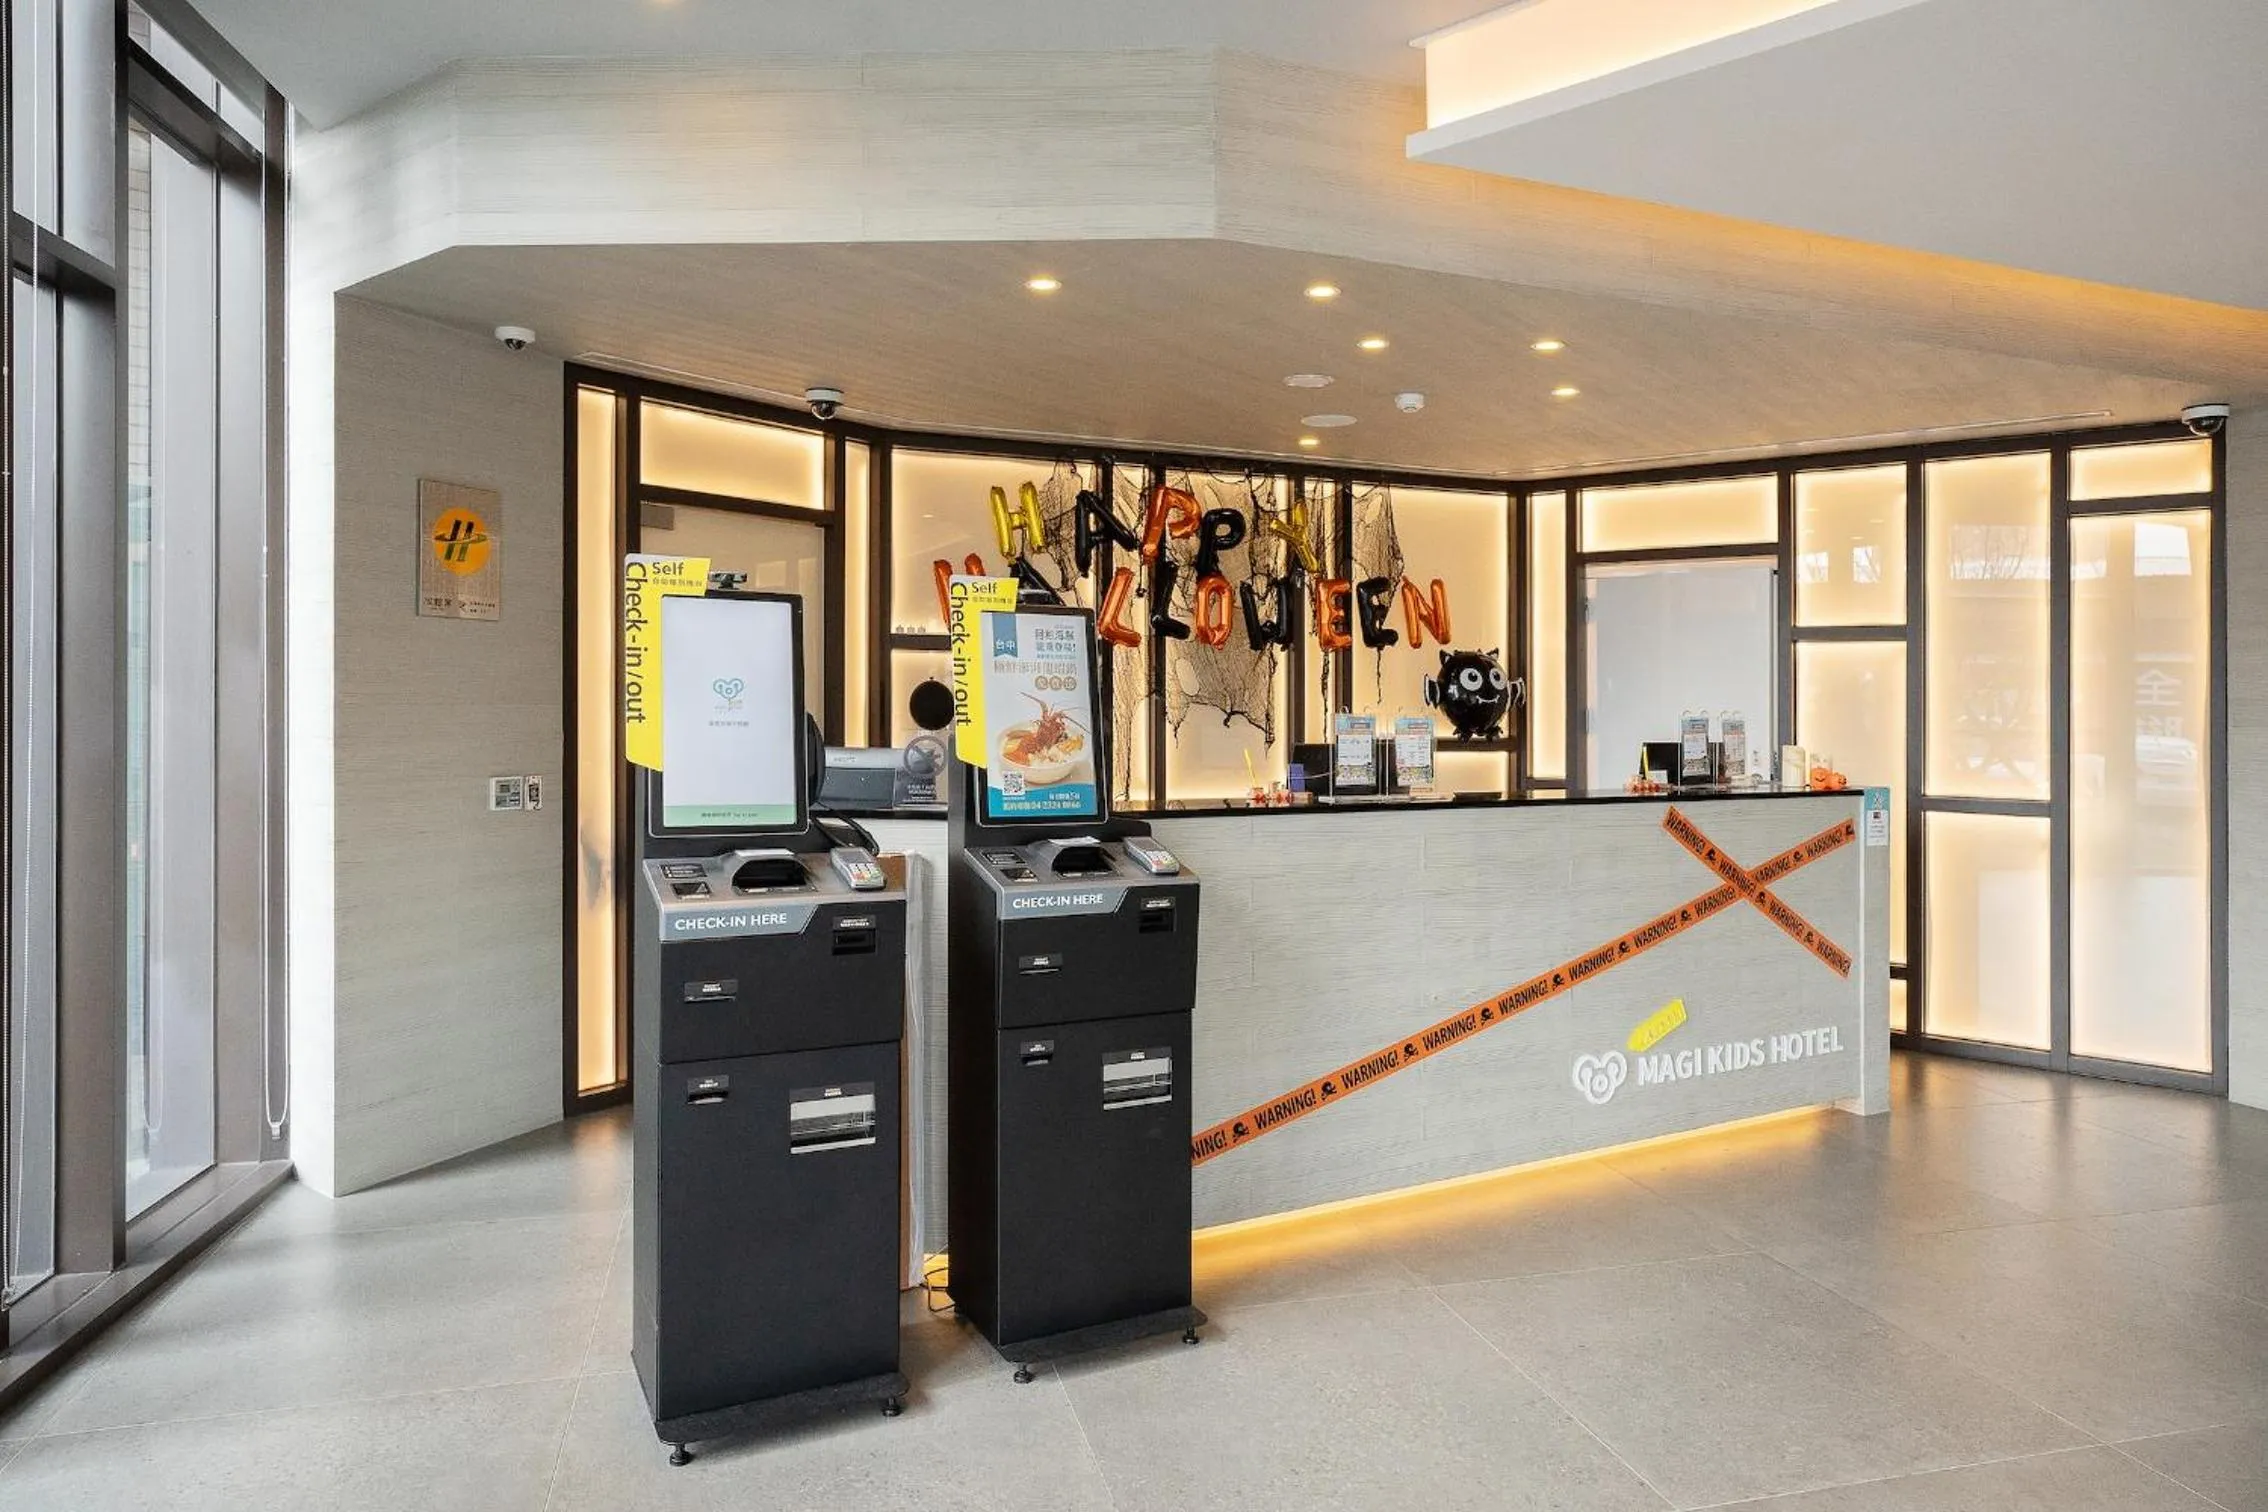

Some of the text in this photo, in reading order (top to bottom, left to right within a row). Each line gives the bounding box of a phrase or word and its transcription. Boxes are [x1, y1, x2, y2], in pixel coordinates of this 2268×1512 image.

[990, 481, 1319, 575] HAPPY
[652, 562, 684, 575] Self
[971, 582, 998, 594] Self
[625, 561, 648, 724] Check-in/out
[950, 582, 972, 726] Check-in/out
[1012, 893, 1103, 909] CHECK-IN HERE
[1666, 811, 1706, 856] WARNING!
[1768, 901, 1804, 939] WARNING!
[674, 912, 788, 931] CHECK-IN HERE
[1254, 1088, 1317, 1130] WARNING!
[1341, 1049, 1400, 1090] WARNING!
[1422, 1014, 1477, 1051] WARNING!
[1498, 979, 1549, 1015] WARNING!
[1568, 948, 1615, 982] WARNING!
[1633, 916, 1678, 949] WARNING!
[1694, 886, 1736, 917] WARNING!
[1805, 830, 1843, 857] WARNING!
[1636, 1025, 1844, 1086] MAGI KIDS HOTEL
